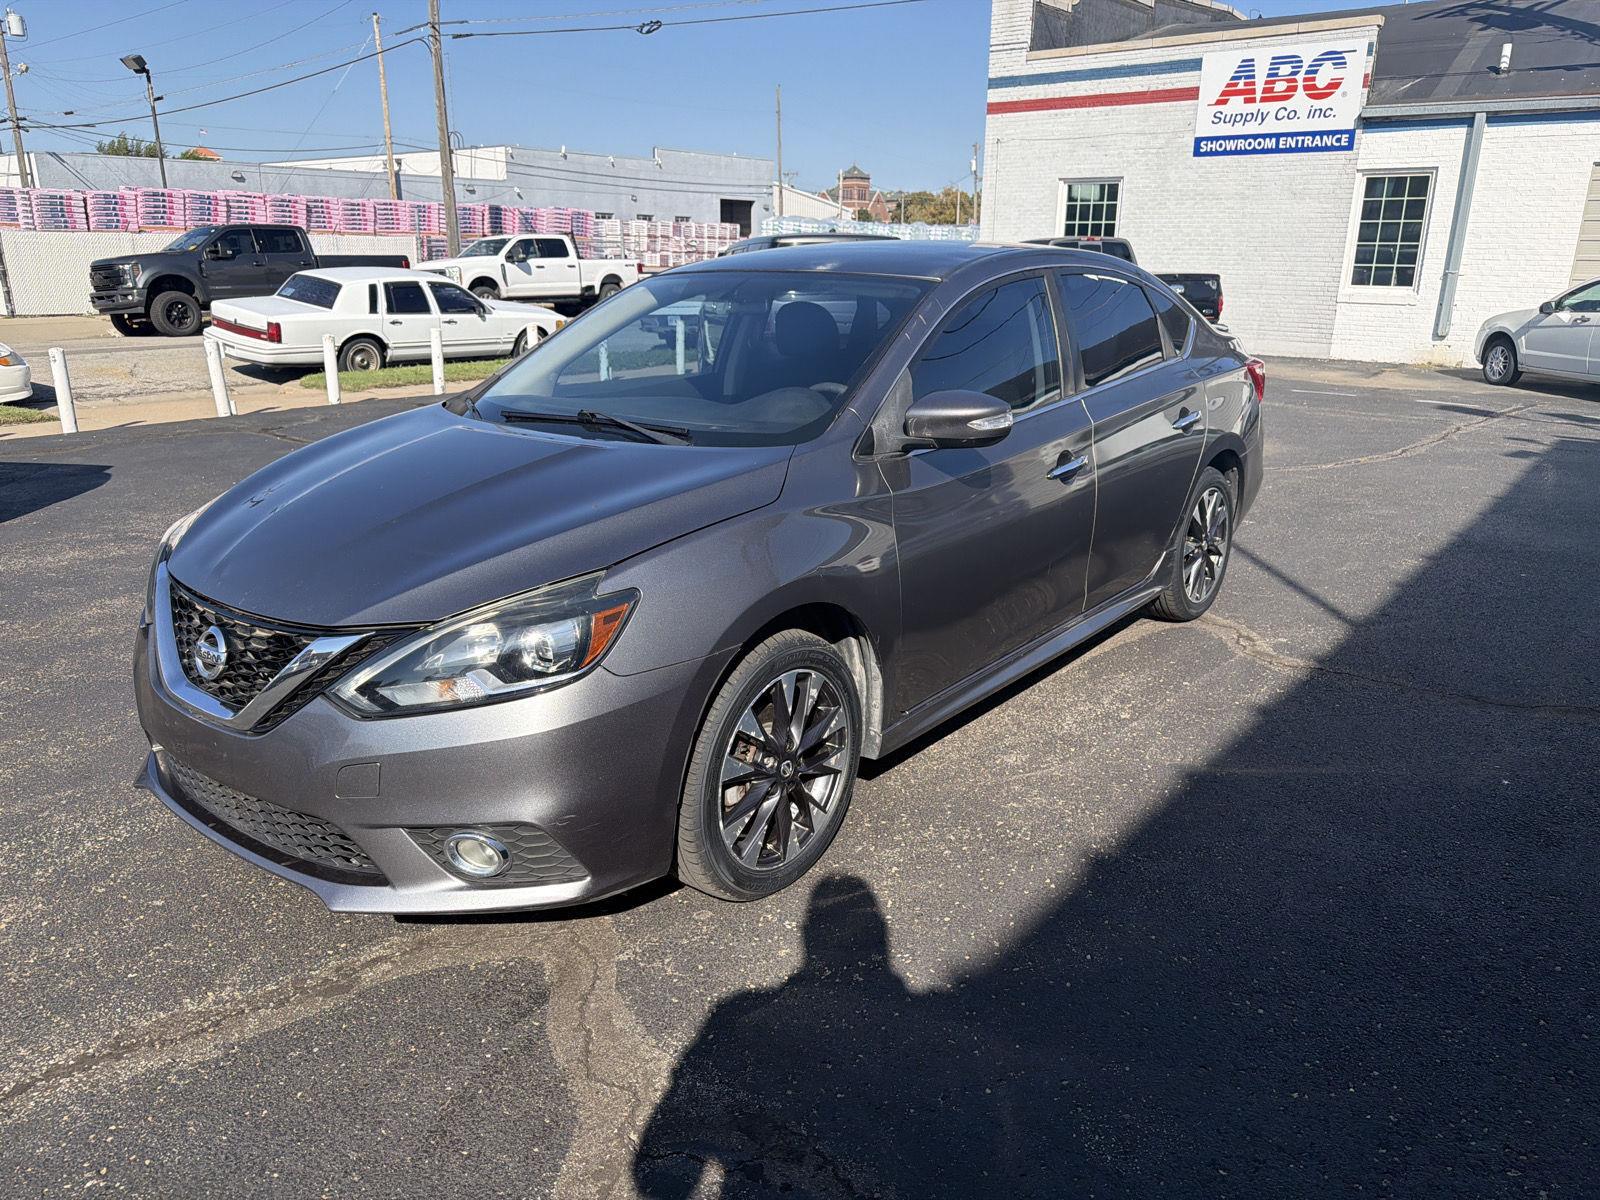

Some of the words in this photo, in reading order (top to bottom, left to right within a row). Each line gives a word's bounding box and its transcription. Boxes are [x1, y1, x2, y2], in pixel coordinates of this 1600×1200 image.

[1207, 50, 1357, 106] ABC
[1211, 109, 1270, 127] Supply
[1274, 106, 1301, 121] Co.
[1306, 104, 1337, 119] inc.
[1200, 136, 1276, 152] SHOWROOM
[1279, 134, 1350, 149] ENTRANCE
